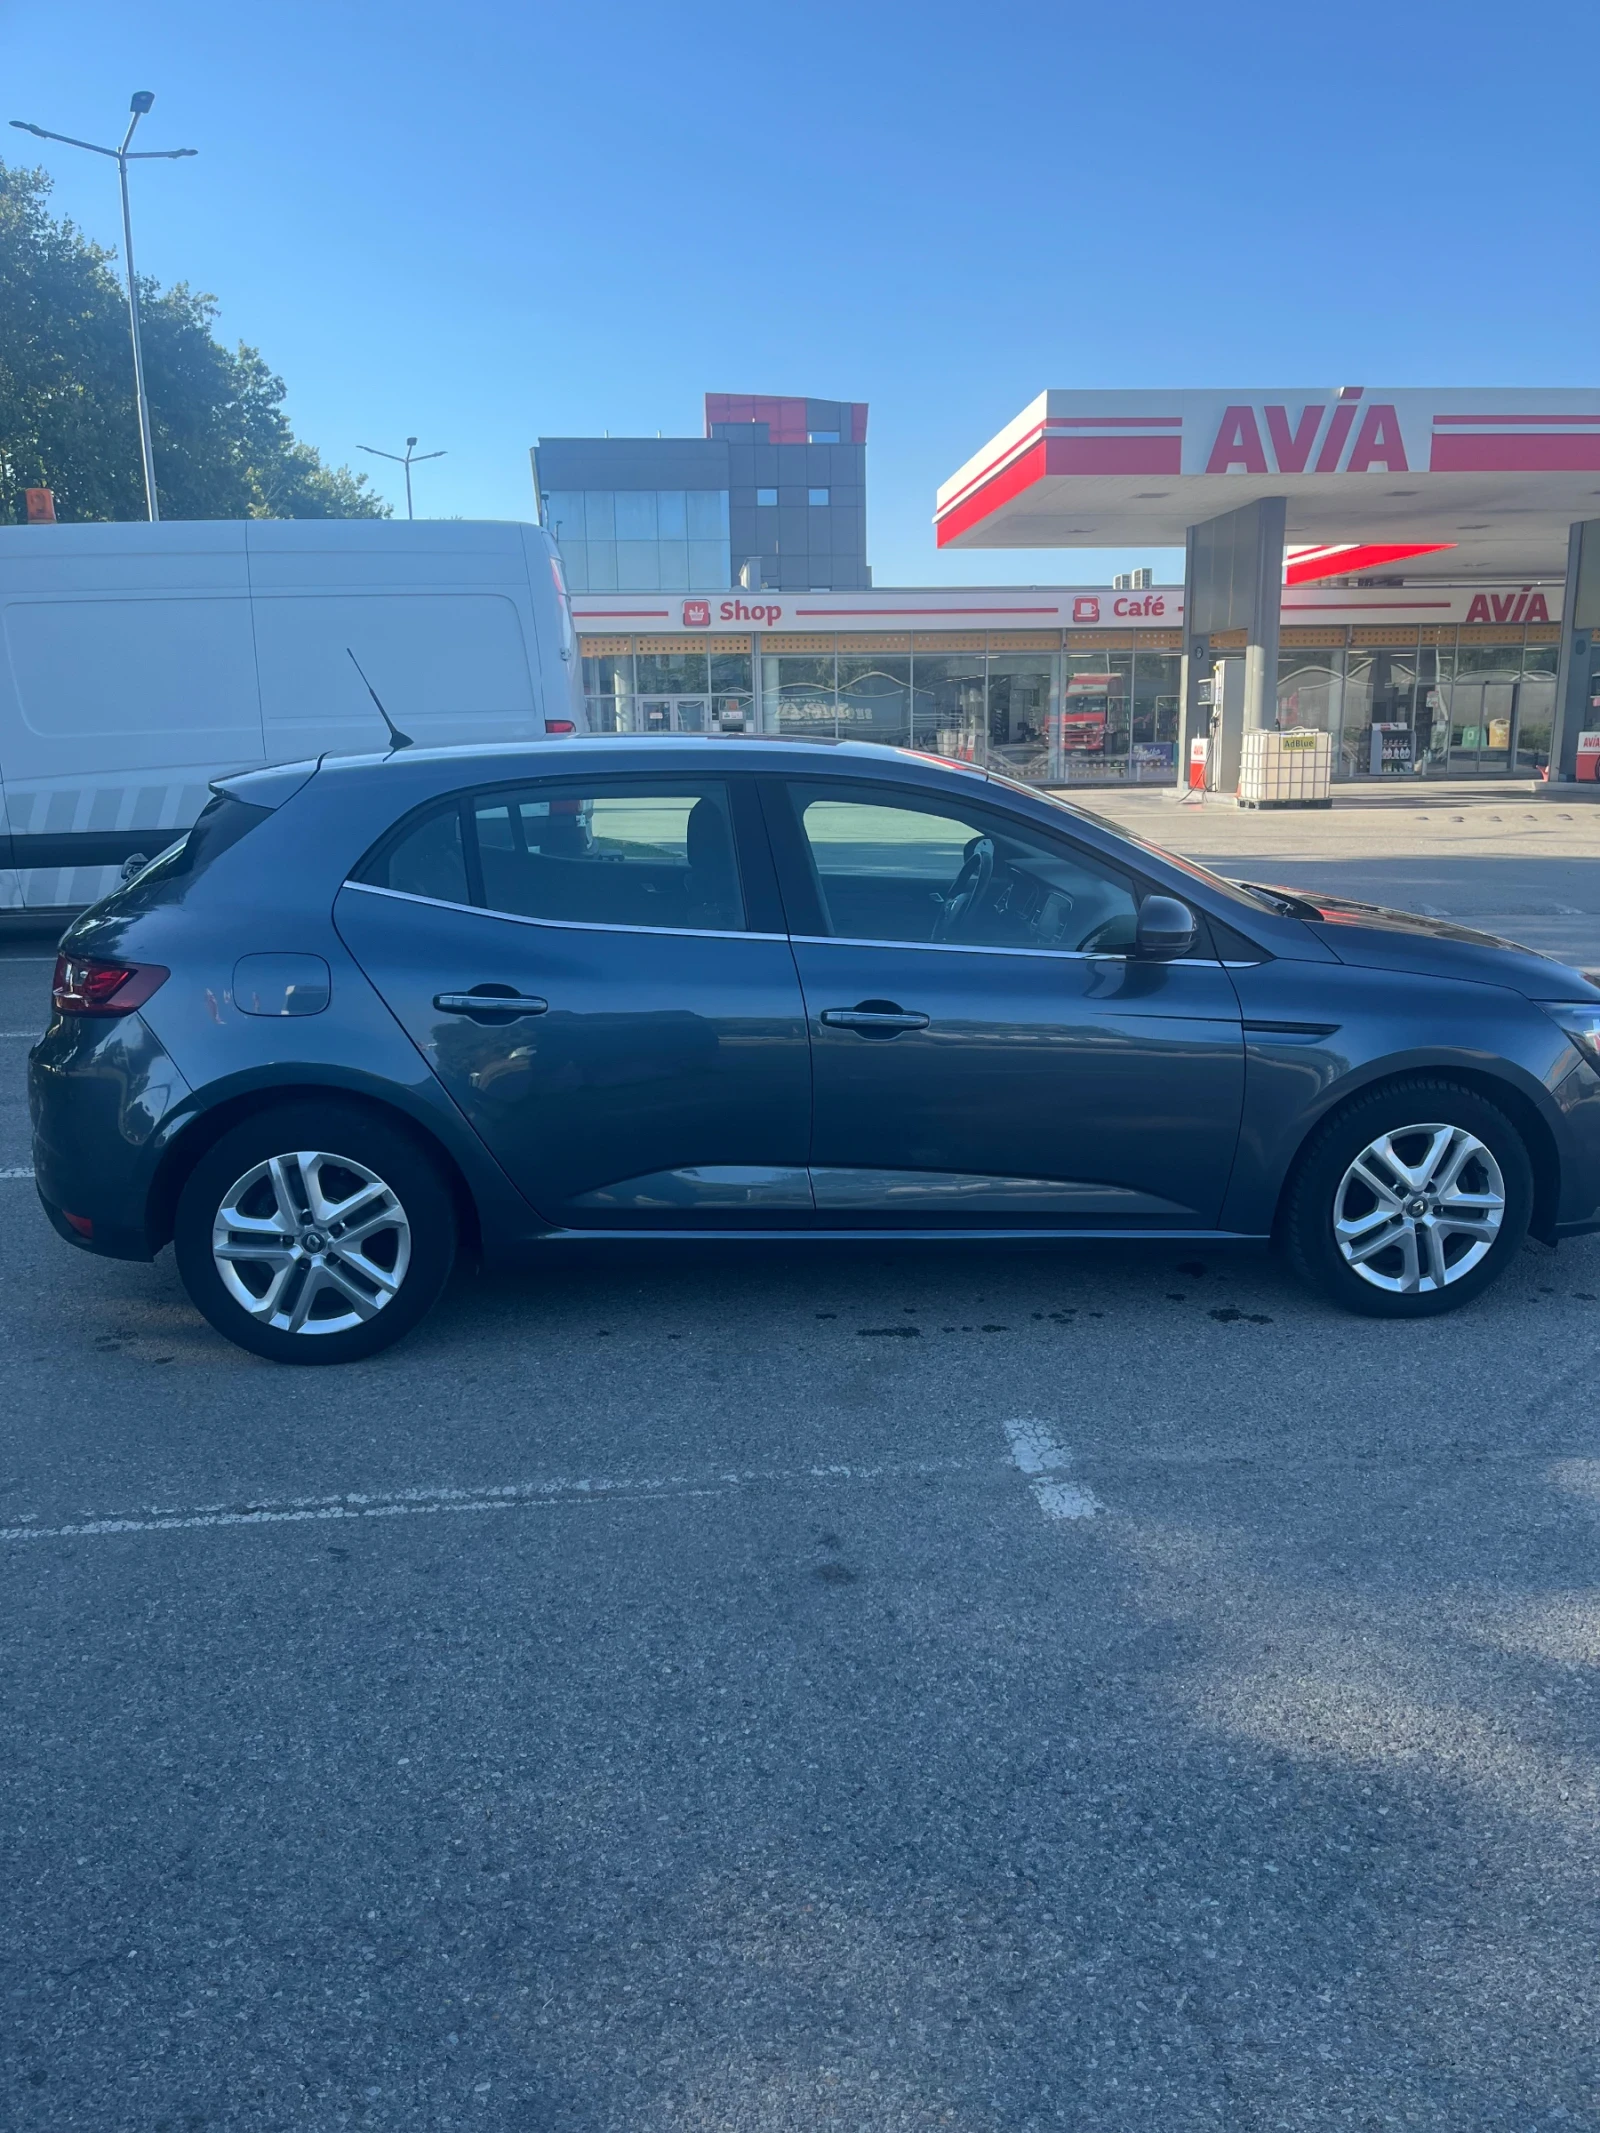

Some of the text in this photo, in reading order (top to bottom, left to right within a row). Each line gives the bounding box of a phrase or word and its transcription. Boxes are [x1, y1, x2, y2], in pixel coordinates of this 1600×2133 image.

[720, 600, 782, 626] Shop
[1113, 595, 1165, 617] Café
[1284, 737, 1314, 749] AdBlue
